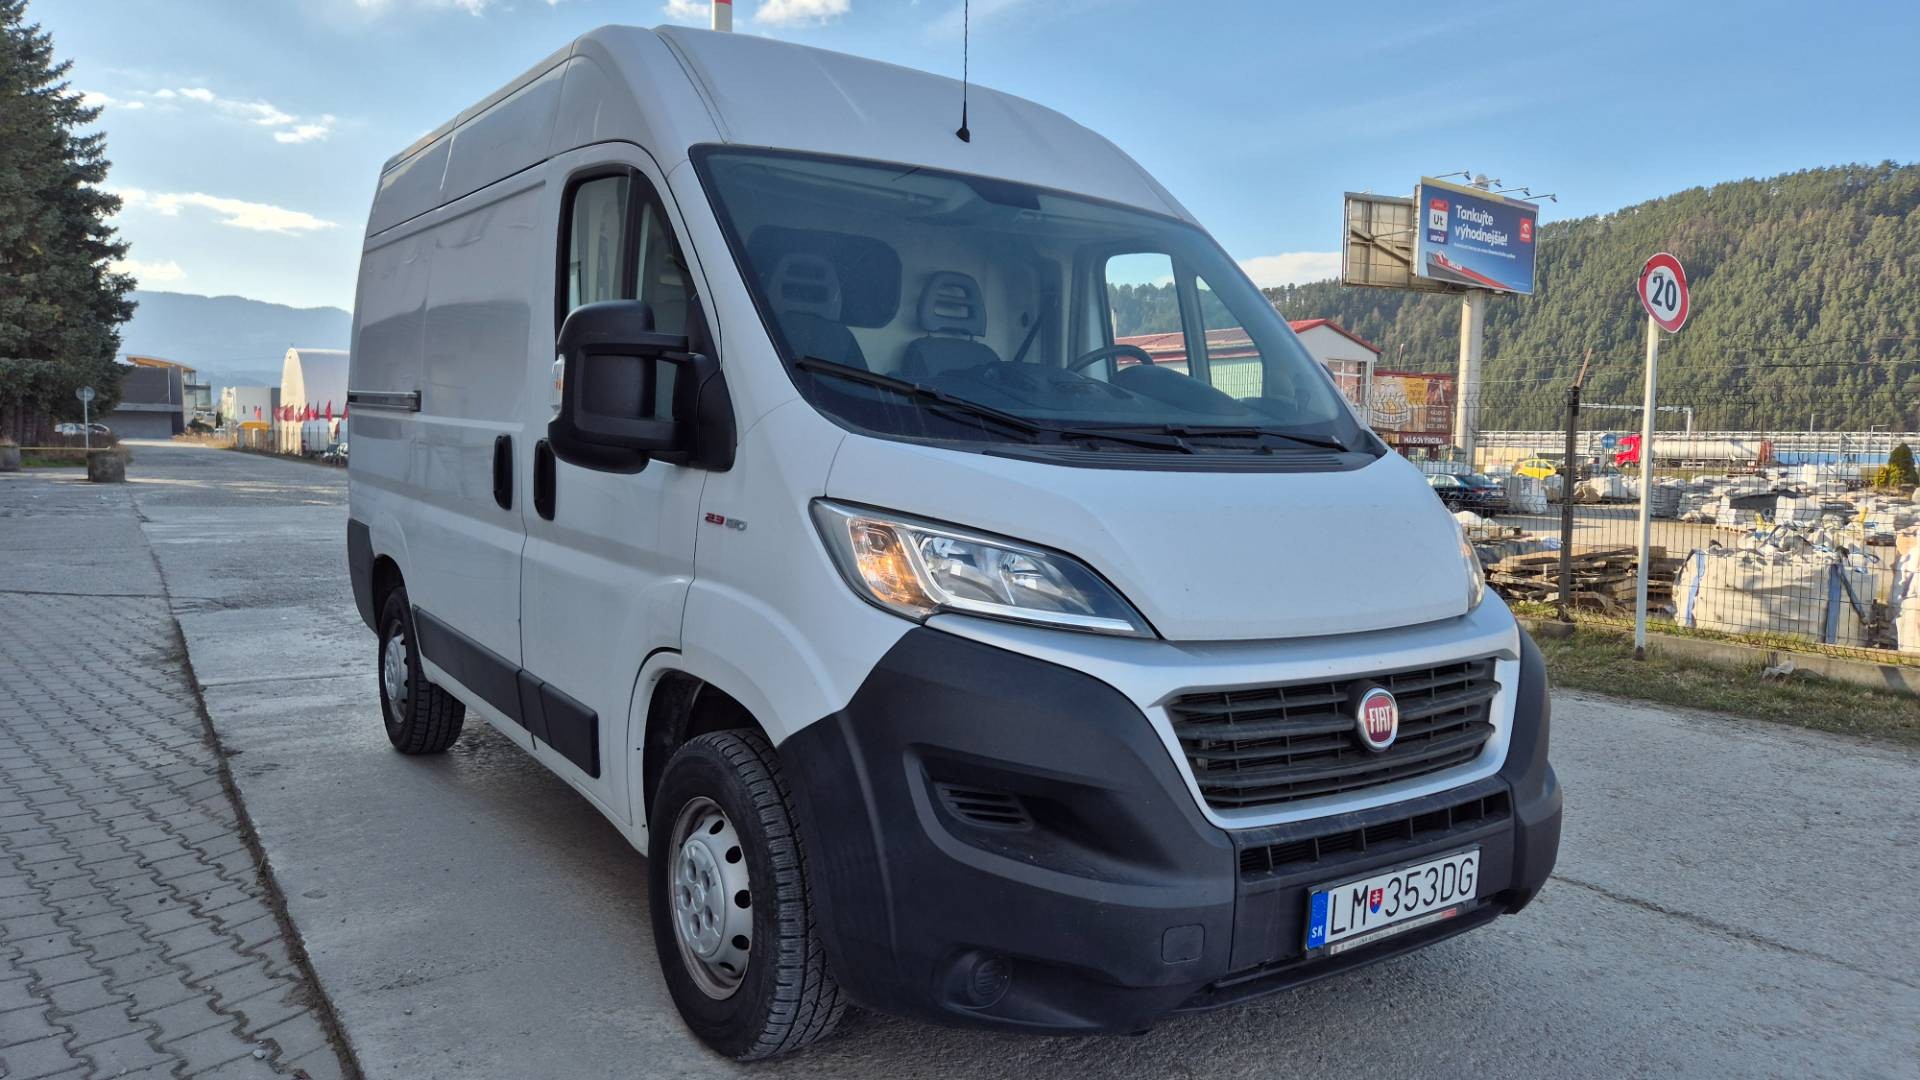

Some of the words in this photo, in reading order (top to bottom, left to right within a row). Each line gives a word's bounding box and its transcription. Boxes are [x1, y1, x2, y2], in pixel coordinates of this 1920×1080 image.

[1455, 204, 1494, 227] Tankujte
[1454, 225, 1508, 247] výhodnejšie!
[1651, 275, 1677, 311] 20
[1369, 706, 1391, 734] FIAT
[1312, 925, 1323, 939] SK
[1331, 885, 1369, 935] LM
[1385, 857, 1474, 917] 353DG
